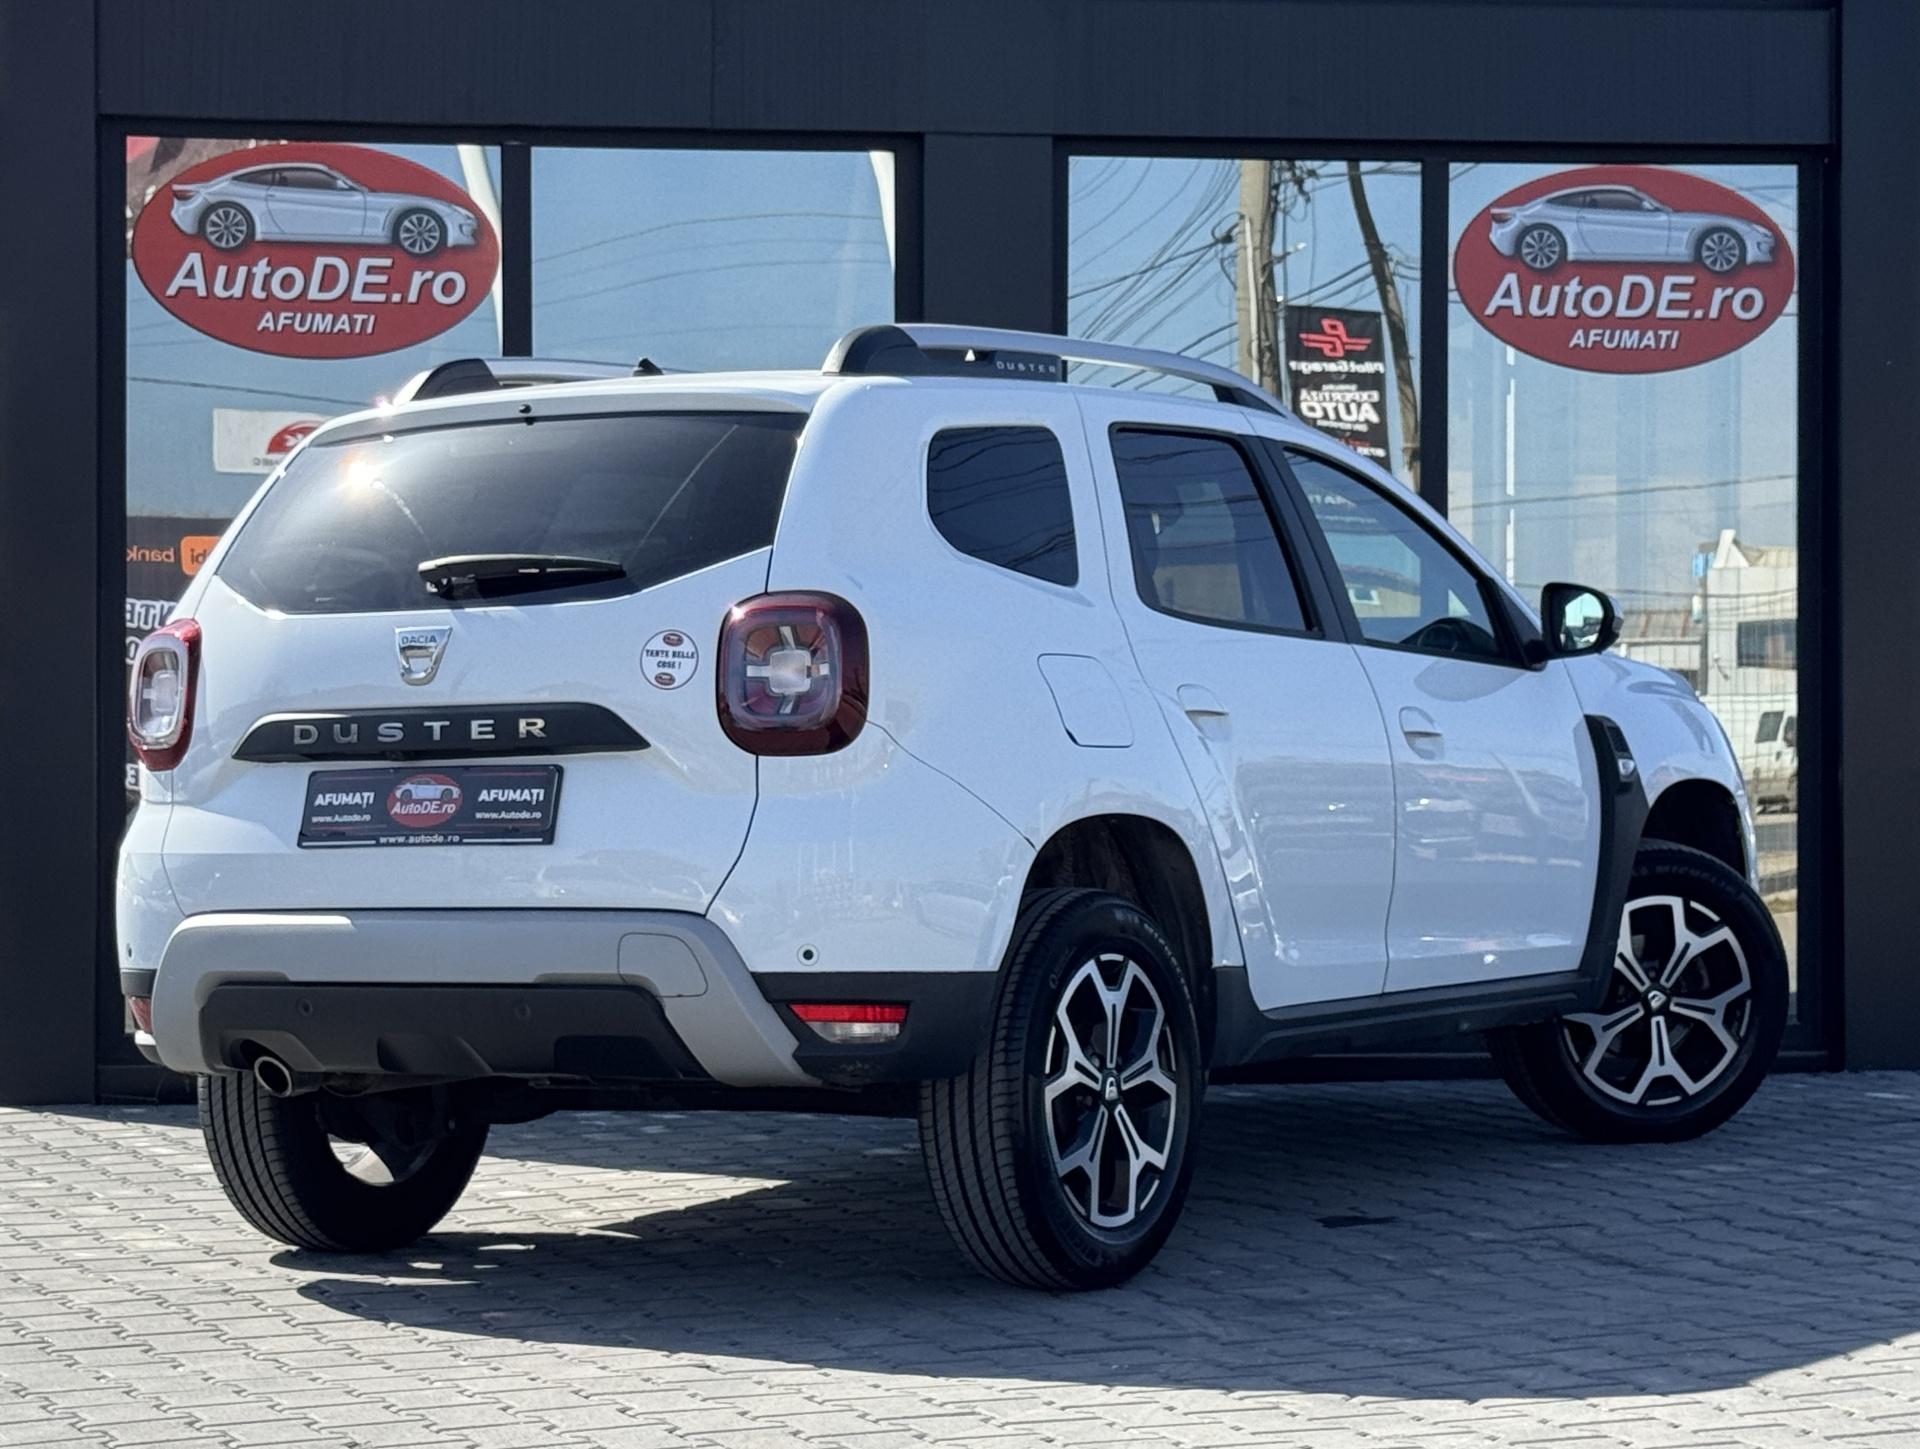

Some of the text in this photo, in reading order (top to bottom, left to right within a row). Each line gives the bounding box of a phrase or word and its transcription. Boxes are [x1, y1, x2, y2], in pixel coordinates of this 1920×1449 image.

[165, 252, 466, 306] AutoDE.ro
[1484, 273, 1765, 321] AutoDE.ro
[257, 311, 376, 335] AFUMATI
[1568, 329, 1680, 350] AFUMATI
[996, 361, 1056, 374] DUSTER
[401, 635, 437, 645] DACIA
[293, 718, 547, 746] DUSTER
[390, 801, 457, 816] AutoDE.ro
